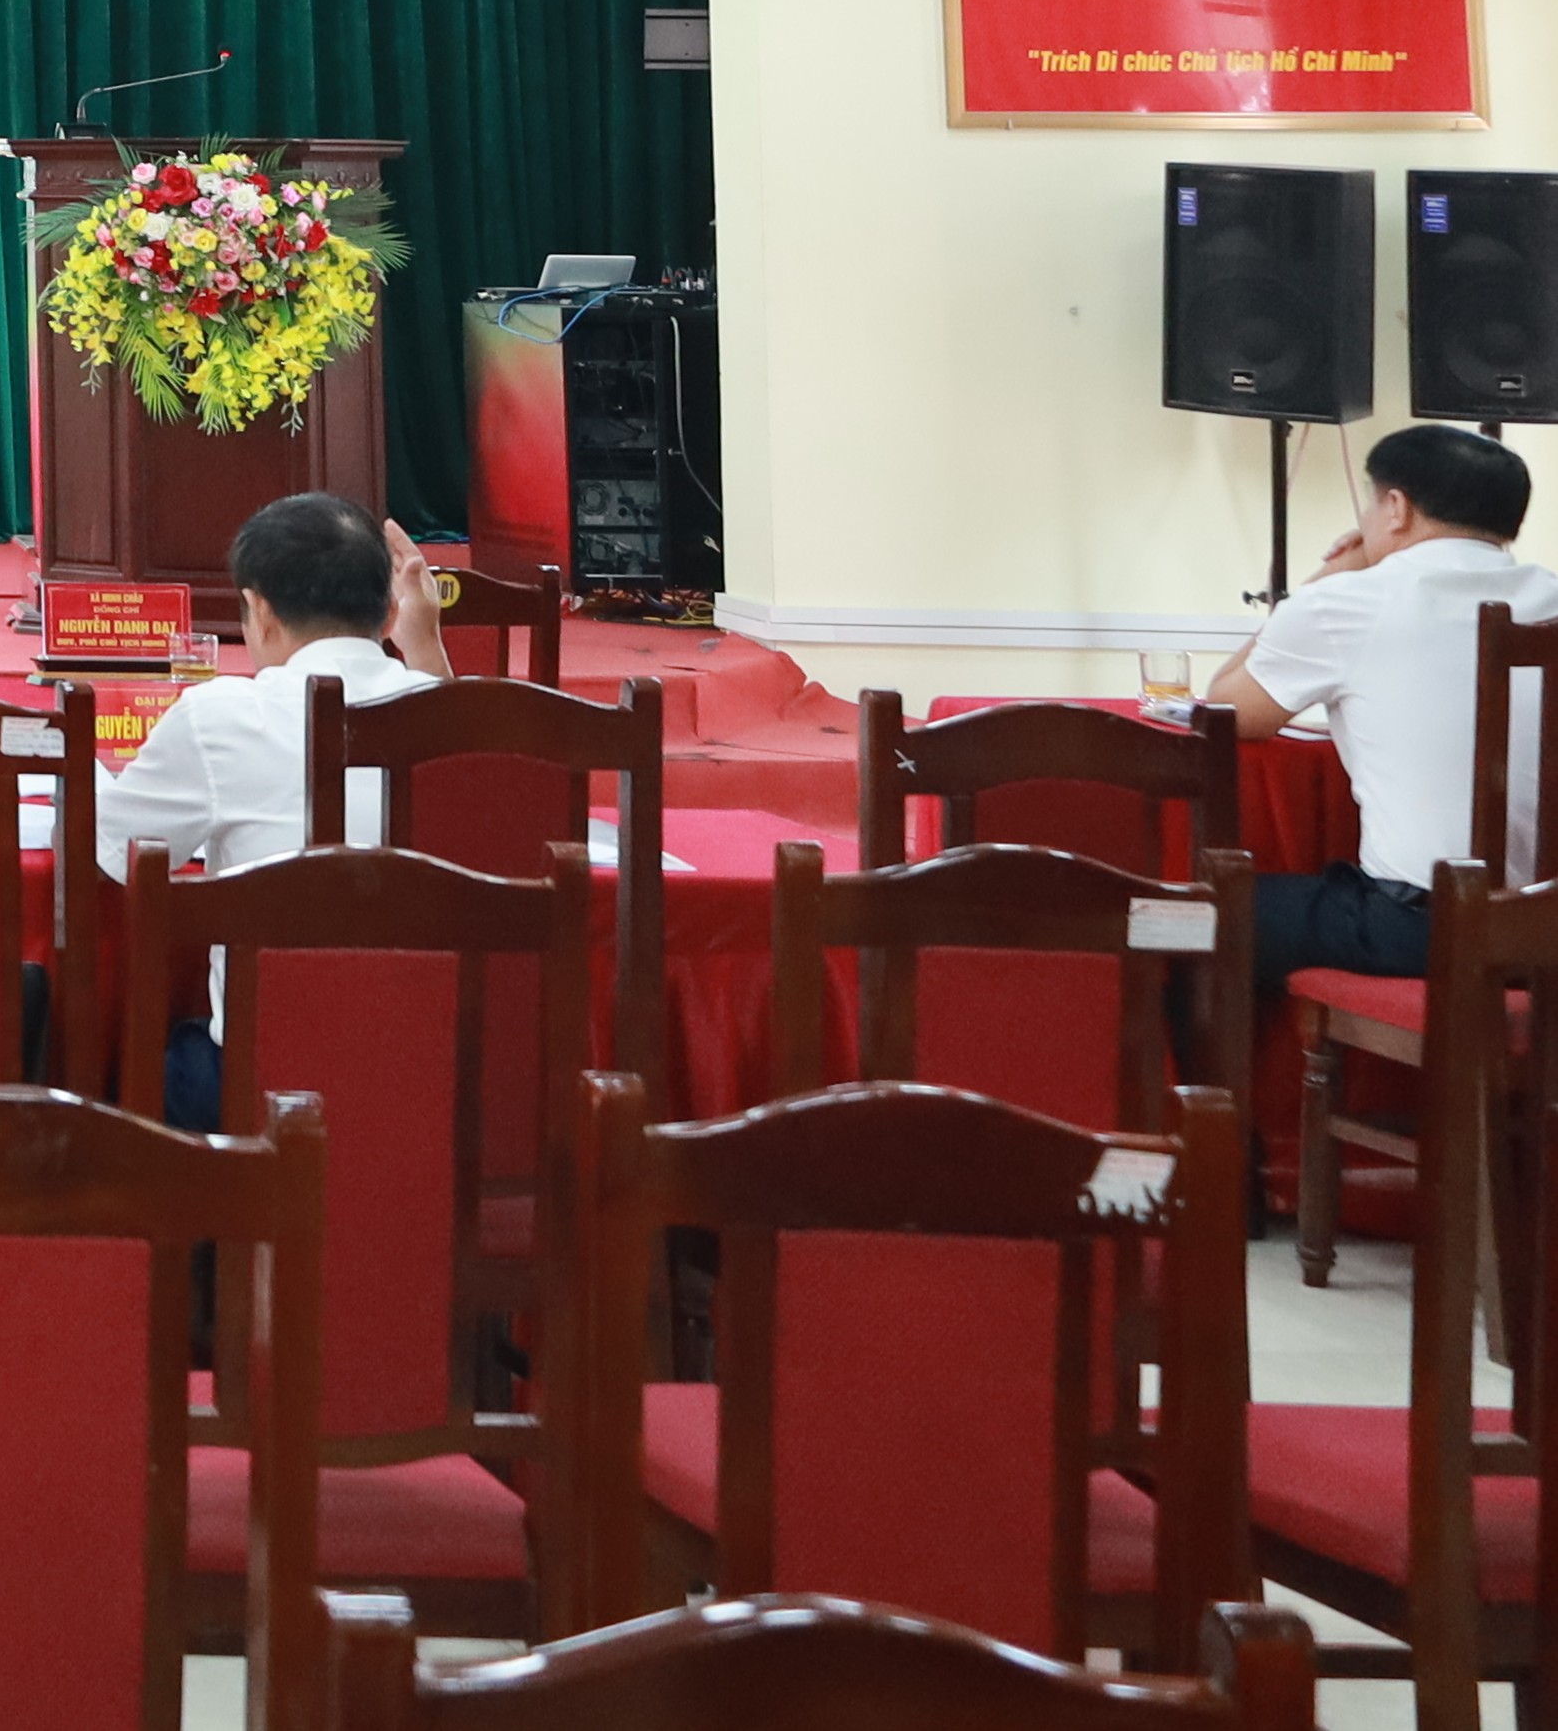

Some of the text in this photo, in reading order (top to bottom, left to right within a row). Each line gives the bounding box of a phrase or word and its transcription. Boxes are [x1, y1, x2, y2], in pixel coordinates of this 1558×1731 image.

[1097, 50, 1119, 72] Di
[1123, 50, 1172, 72] chúc
[1179, 48, 1217, 72] Chủ
[1227, 50, 1265, 76] tịch
[1271, 46, 1299, 71] Hồ
[1302, 49, 1337, 71] Chí
[93, 604, 140, 614] ĐỒNG CHÍ
[59, 614, 177, 637] NGUYỄN DANH ĐẠT
[134, 696, 155, 708] ĐẠI
[96, 706, 143, 740] GUYỄN
